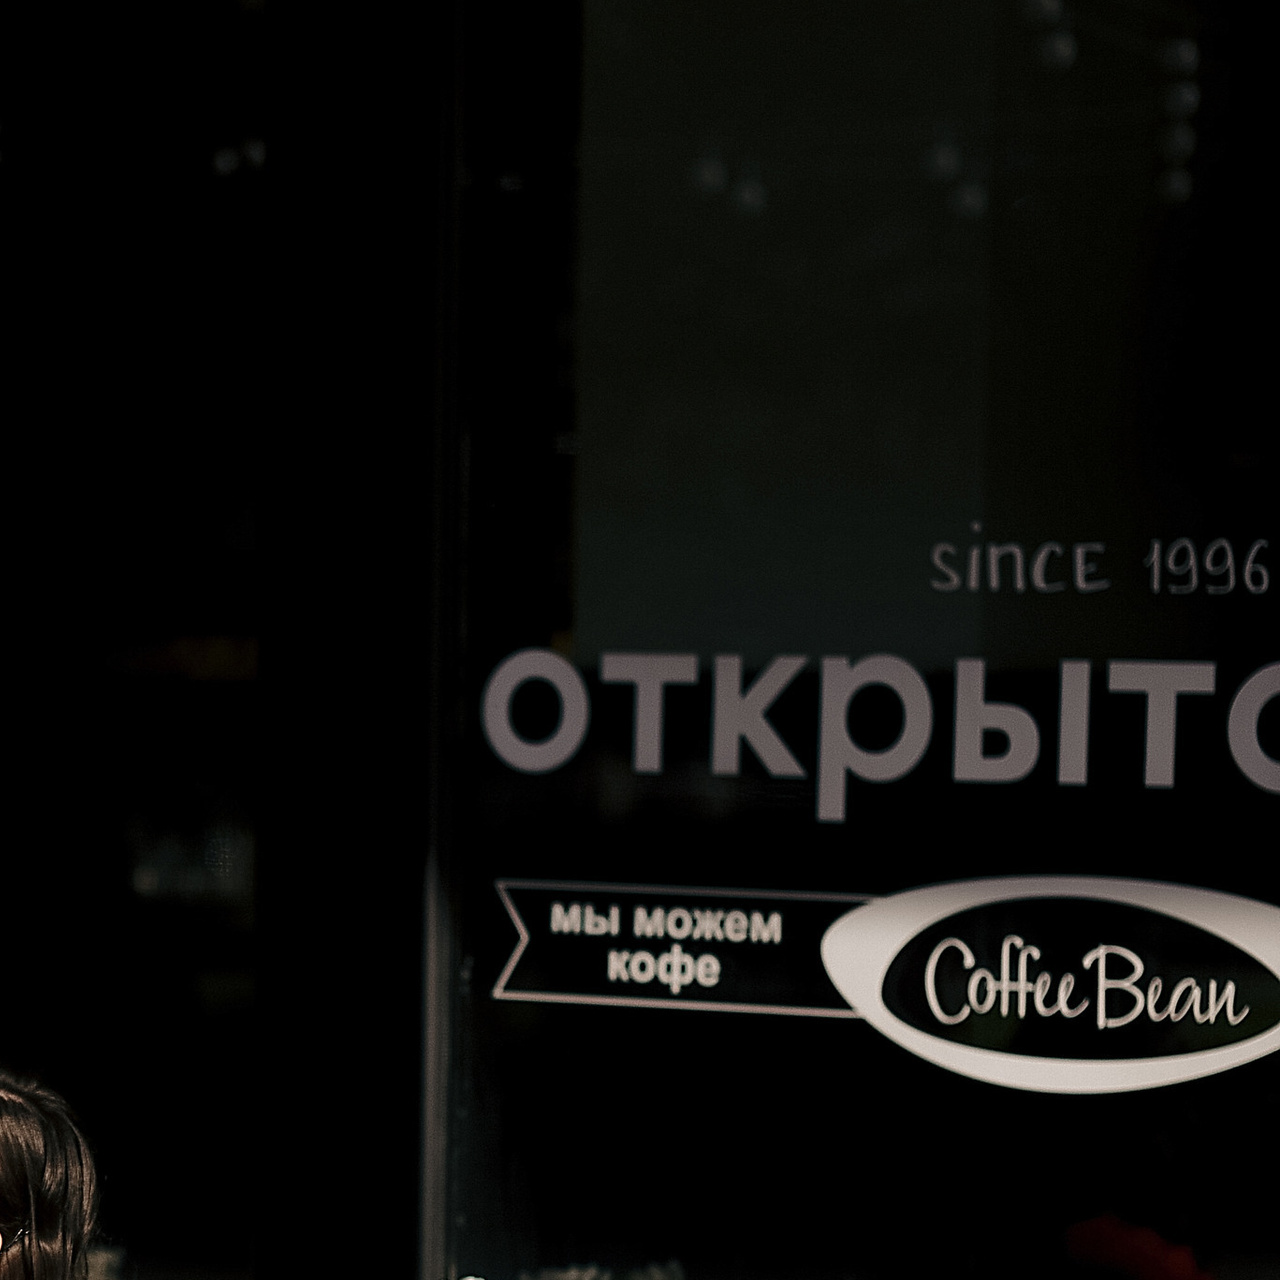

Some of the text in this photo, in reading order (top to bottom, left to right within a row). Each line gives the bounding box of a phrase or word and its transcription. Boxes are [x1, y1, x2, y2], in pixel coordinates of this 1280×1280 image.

[1142, 537, 1271, 595] 1996
[550, 902, 783, 946] мы можем
[606, 943, 722, 996] кофе
[923, 935, 1251, 1031] Coffee Bean
